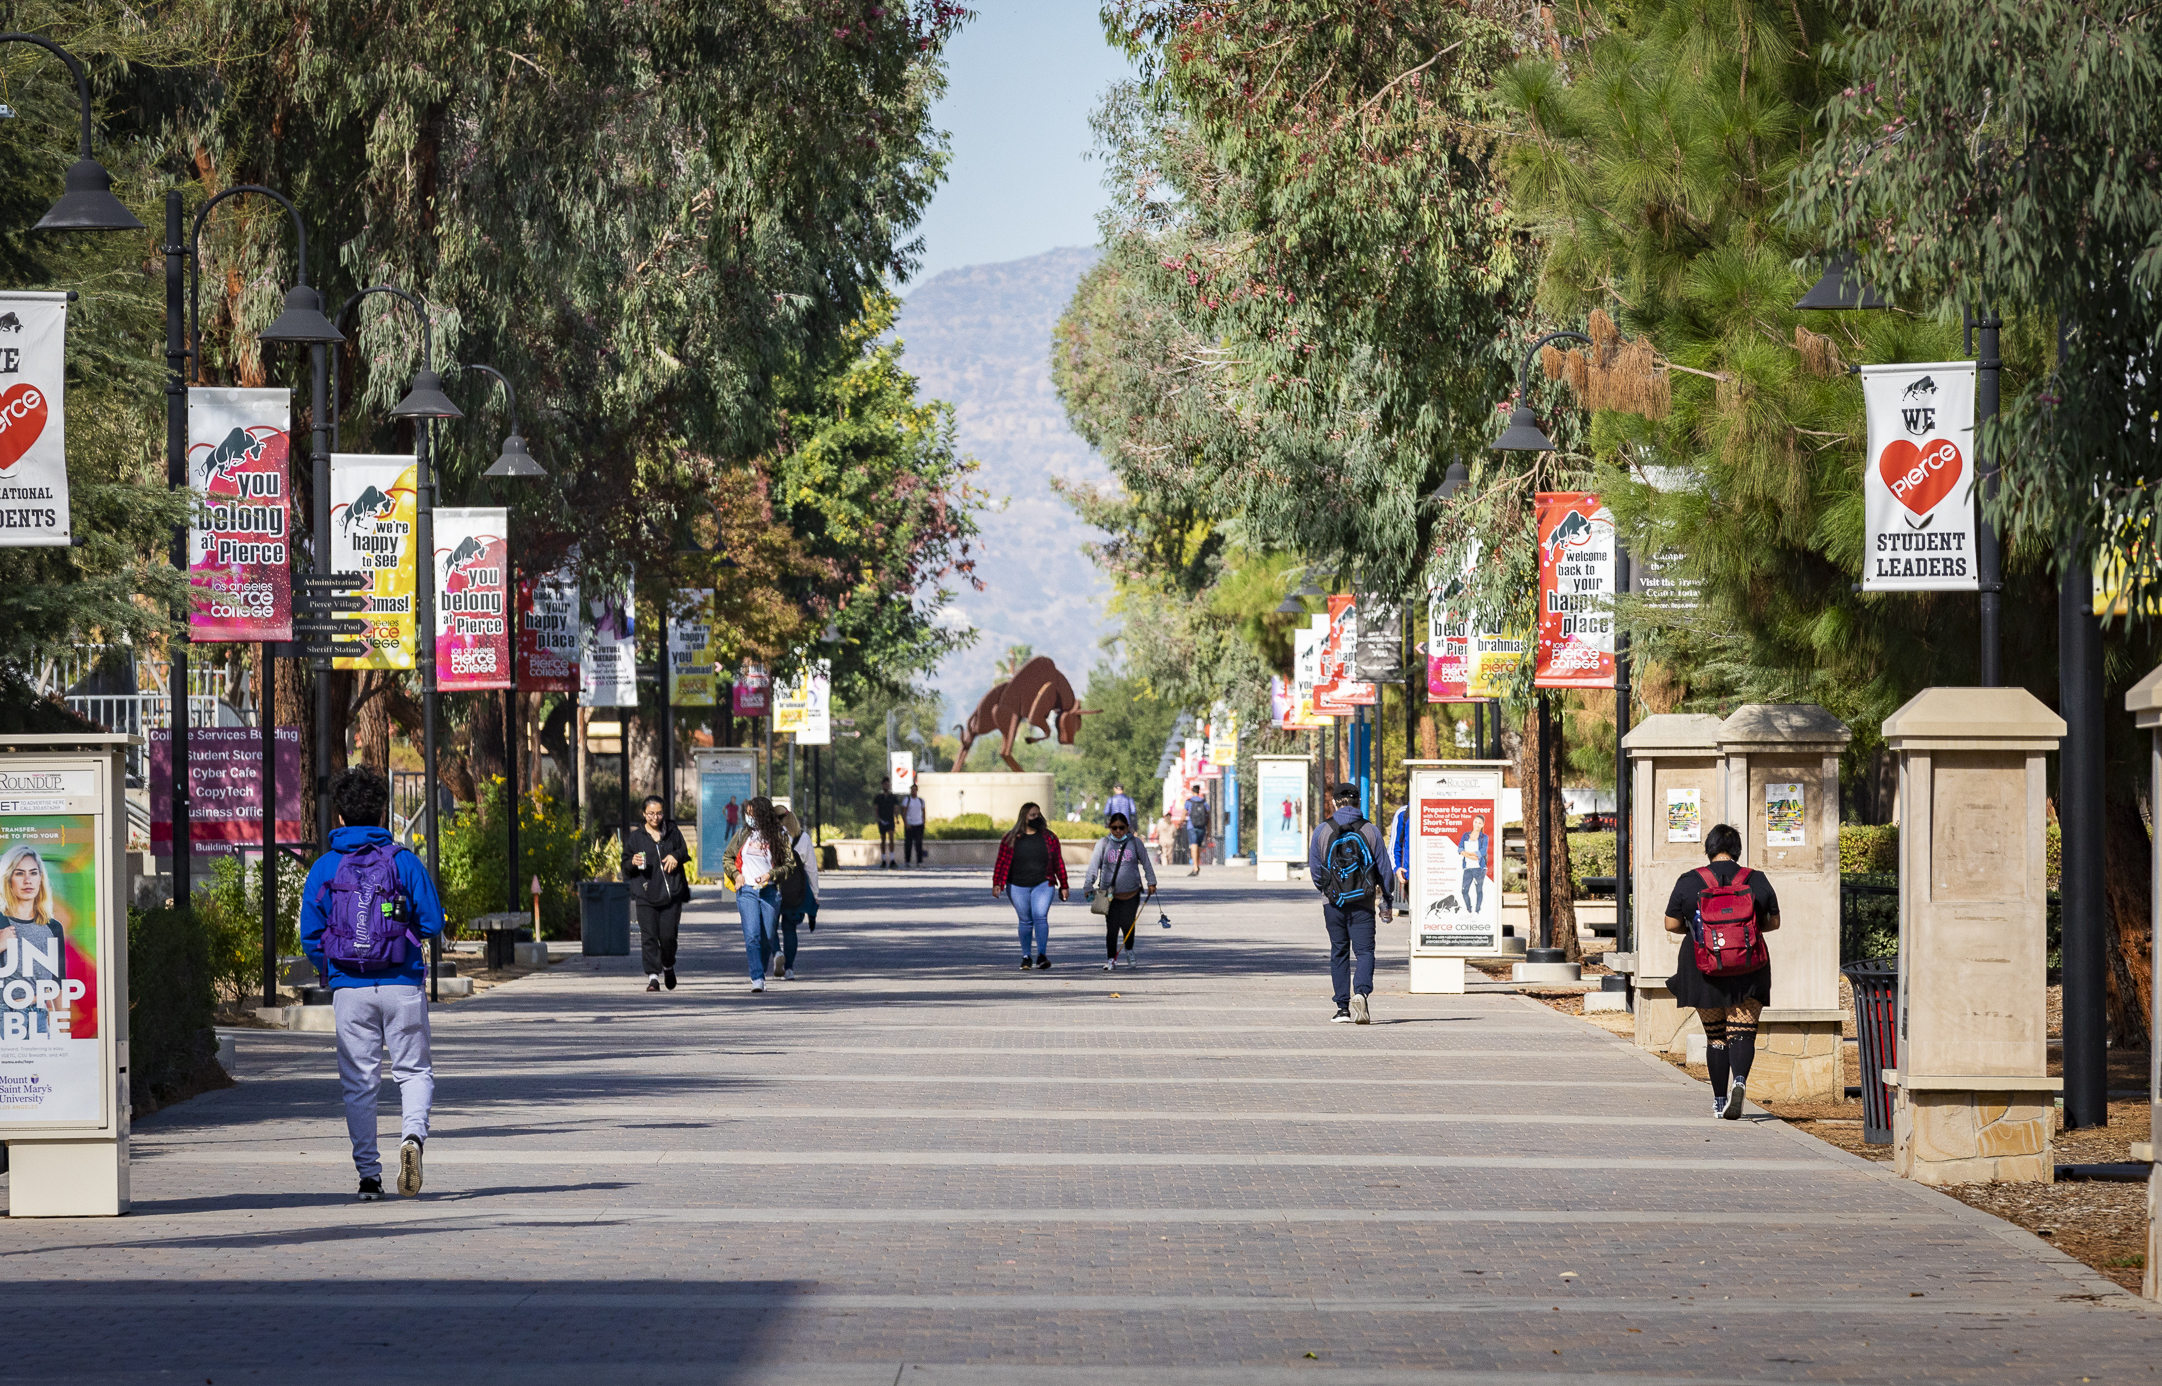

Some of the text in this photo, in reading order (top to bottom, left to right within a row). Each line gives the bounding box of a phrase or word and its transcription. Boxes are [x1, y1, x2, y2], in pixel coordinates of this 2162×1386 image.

[0, 348, 19, 373] E
[1901, 408, 1936, 430] WE
[237, 473, 280, 498] you
[0, 487, 53, 499] ATIONAL
[199, 501, 284, 536] belong
[376, 521, 409, 534] we're
[201, 534, 284, 562] at Pierce
[353, 533, 399, 554] happy
[1877, 532, 1966, 551] STUDENT
[362, 555, 397, 568] to see
[1566, 551, 1607, 561] welcome
[1558, 564, 1595, 576] back to
[1876, 557, 1967, 577] LEADERS
[303, 579, 361, 587] Administration
[468, 569, 498, 587] you
[1639, 578, 1676, 586] Visit the
[1573, 578, 1603, 593] your
[441, 590, 501, 613] belong
[533, 590, 552, 600] back
[310, 600, 361, 609] Pierce Village
[368, 595, 409, 612] hmas!
[546, 602, 571, 614] your
[343, 623, 361, 631] Pool
[444, 614, 502, 633] at Pierce
[526, 612, 567, 631] happy
[1563, 615, 1609, 636] place
[538, 632, 575, 649] place
[680, 632, 706, 642] happy
[1436, 639, 1467, 655] at Pier
[672, 651, 692, 665] you
[150, 729, 298, 742] Colle Services Buding
[233, 750, 263, 760] Store
[193, 767, 257, 781] Cyber Cafe
[196, 786, 254, 799] CopyTech
[188, 806, 263, 817] usiness Offic
[1423, 806, 1450, 814] Prepare
[1423, 826, 1458, 834] Programs:
[195, 843, 232, 853] Building
[0, 979, 86, 1009] OPP
[0, 1011, 72, 1040] BLE
[0, 1076, 28, 1084] Mount
[0, 1084, 52, 1095] Saint Mary's
[0, 1094, 44, 1104] University
